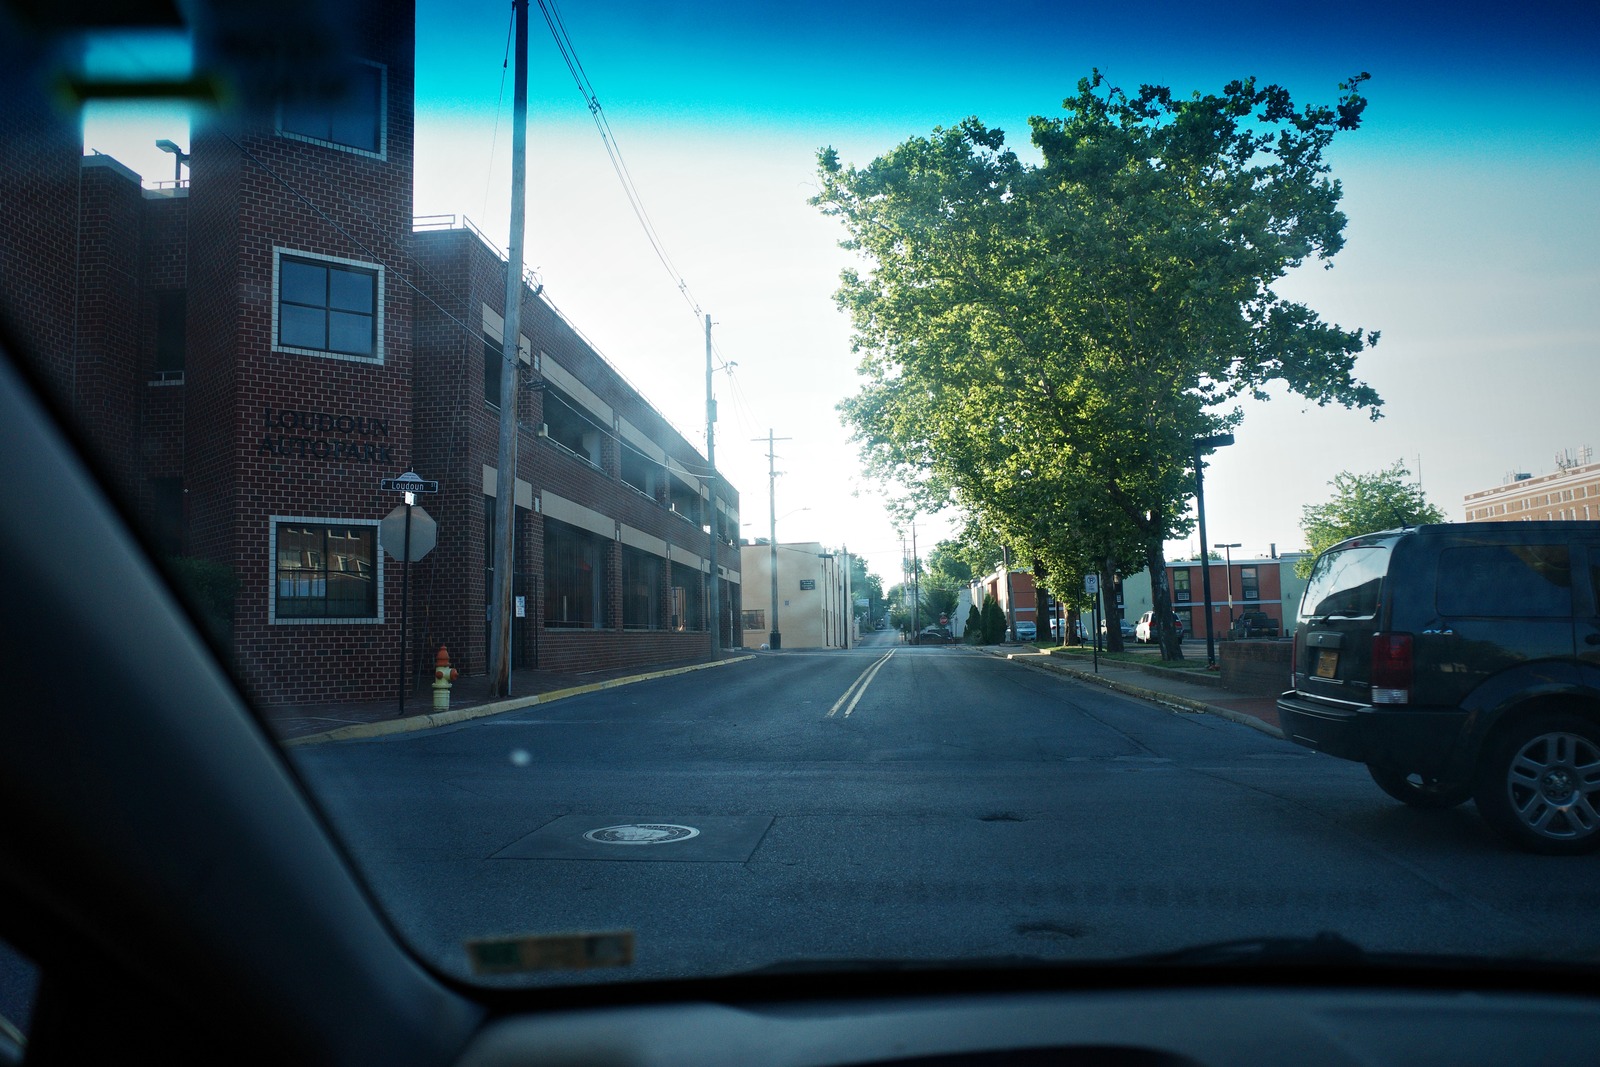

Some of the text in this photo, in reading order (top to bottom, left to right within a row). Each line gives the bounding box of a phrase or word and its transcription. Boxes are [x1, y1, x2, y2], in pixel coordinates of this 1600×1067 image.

[265, 408, 389, 436] LOUDOUN
[257, 436, 394, 464] AUTOPARK
[392, 481, 424, 491] Loudoun
